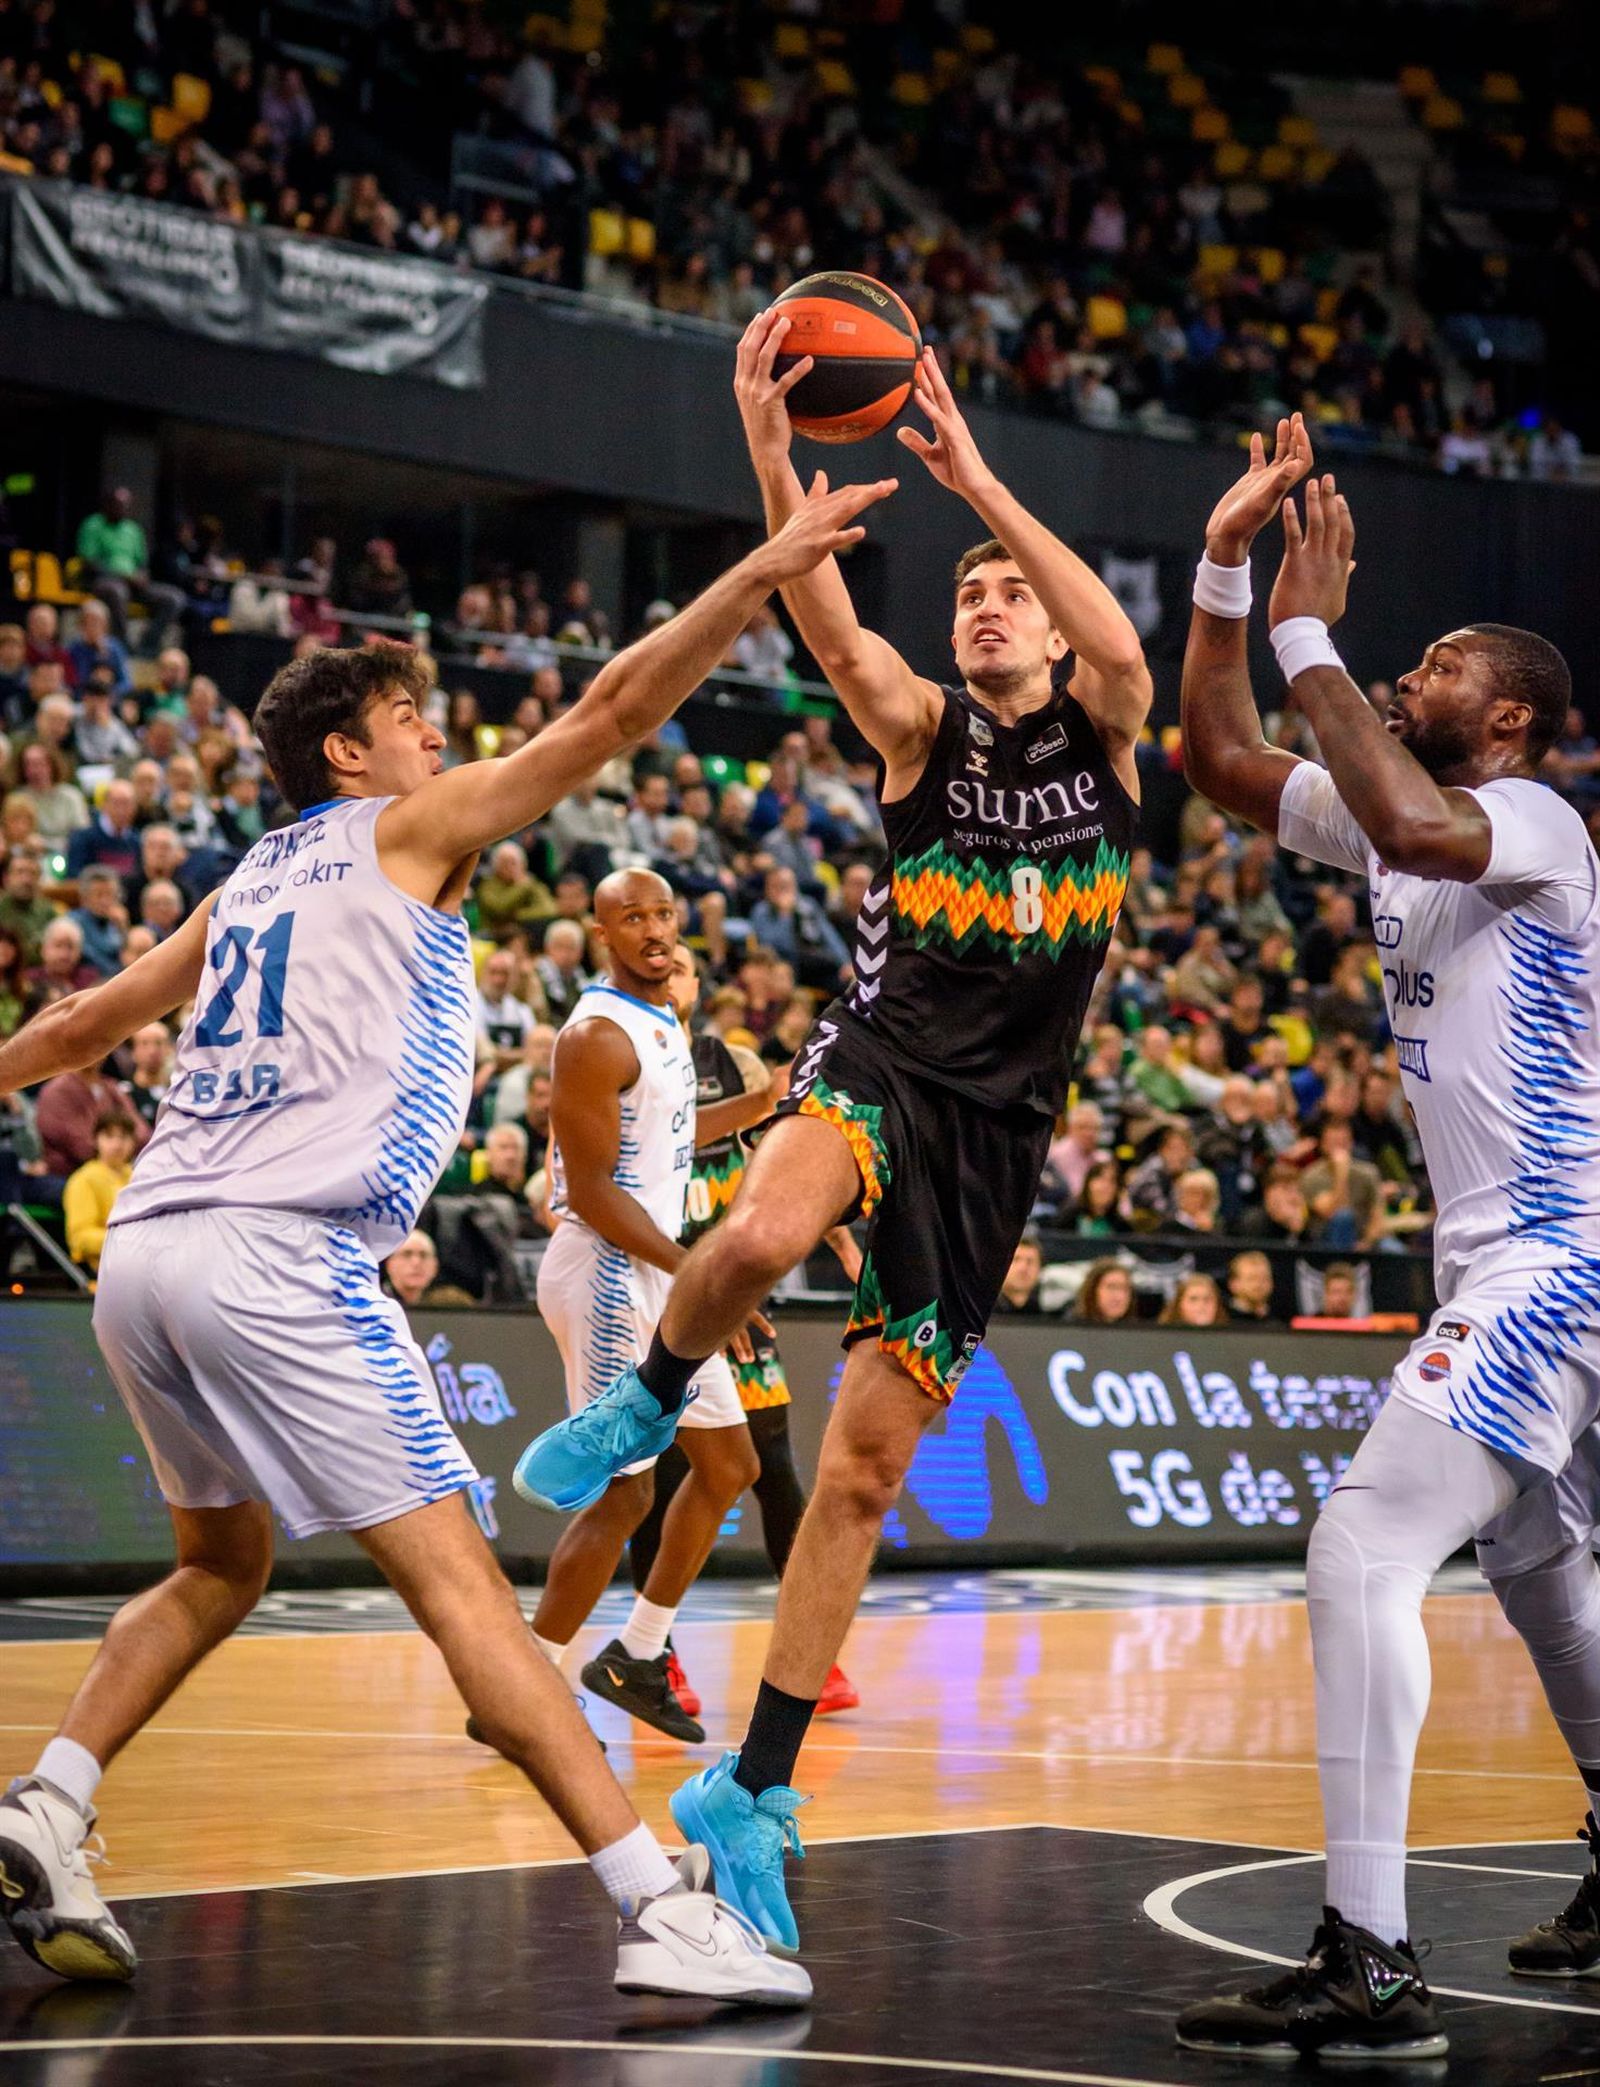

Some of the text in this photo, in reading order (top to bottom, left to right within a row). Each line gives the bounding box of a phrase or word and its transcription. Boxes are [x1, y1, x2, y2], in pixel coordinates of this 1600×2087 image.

[947, 771, 1099, 830] surne
[953, 828, 1011, 849] seguros
[1030, 823, 1104, 854] pensiones
[1011, 866, 1044, 934] 8
[195, 911, 296, 1048] 21
[1439, 1327, 1460, 1339] acb
[1048, 1350, 1177, 1428] Con
[1173, 1351, 1253, 1429] la
[1107, 1448, 1213, 1529] 5G
[1220, 1451, 1301, 1527] de
